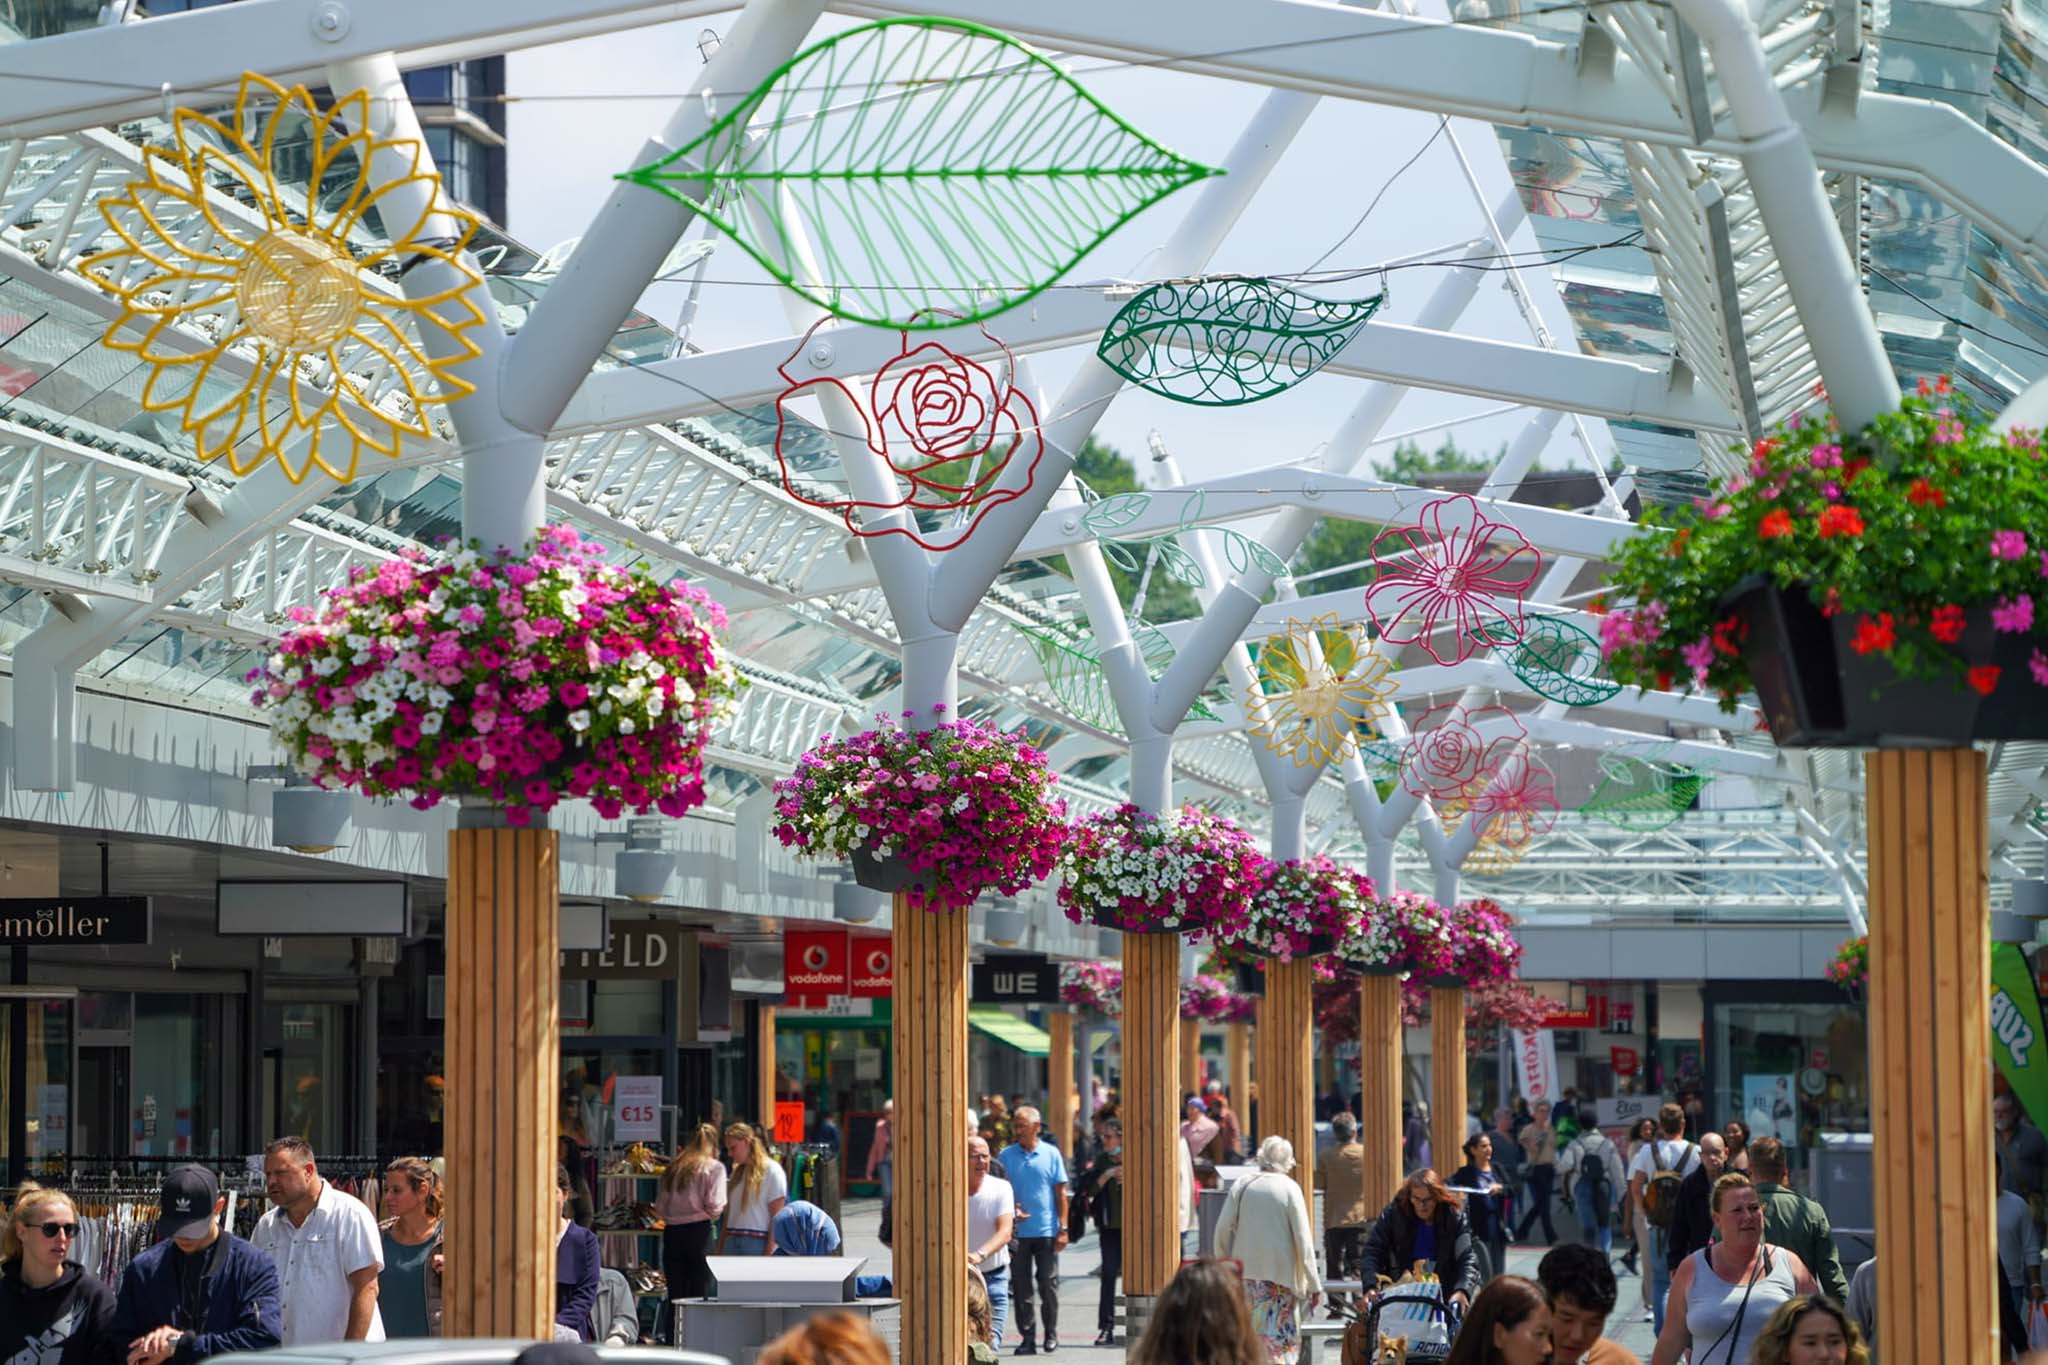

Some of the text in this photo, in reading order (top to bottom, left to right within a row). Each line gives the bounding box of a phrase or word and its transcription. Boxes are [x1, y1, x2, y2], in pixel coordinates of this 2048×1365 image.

[788, 972, 843, 984] vodafone
[854, 977, 892, 987] vodafo
[993, 973, 1038, 993] WE
[620, 1105, 654, 1122] €15
